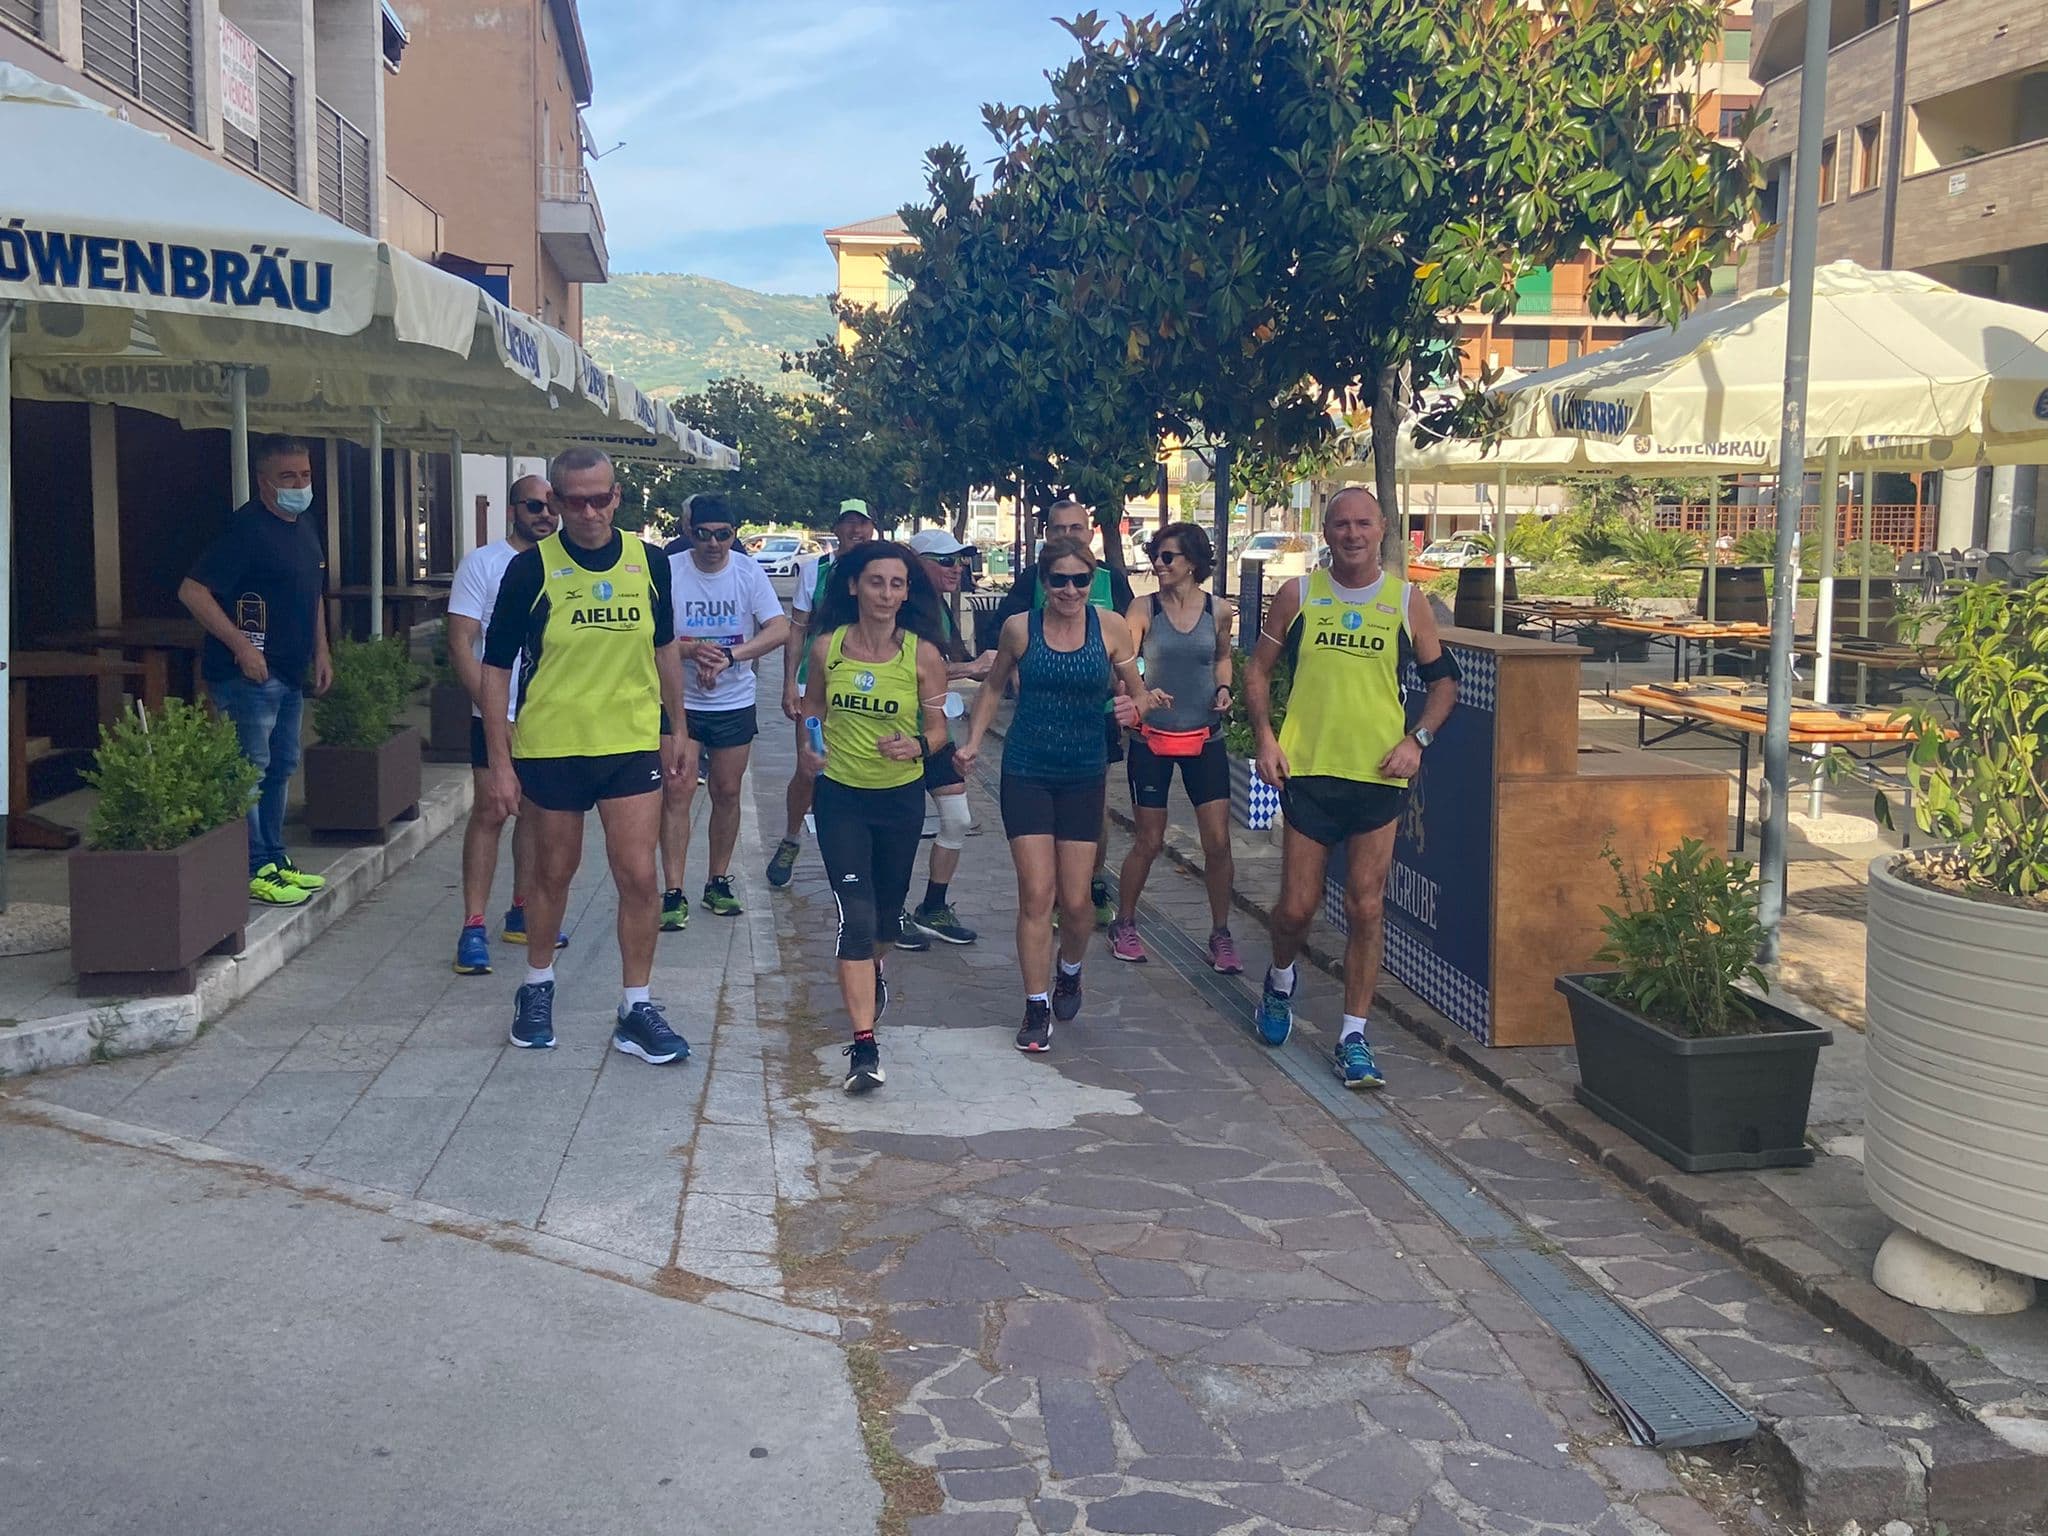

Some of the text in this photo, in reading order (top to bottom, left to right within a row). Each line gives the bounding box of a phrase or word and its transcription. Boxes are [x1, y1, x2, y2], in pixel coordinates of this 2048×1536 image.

[0, 217, 333, 315] ÖWENBRÄU
[571, 606, 641, 625] AIELLO
[1314, 631, 1385, 651] AIELLO
[831, 693, 899, 714] AIELLO
[1385, 860, 1438, 930] NGRUBE
